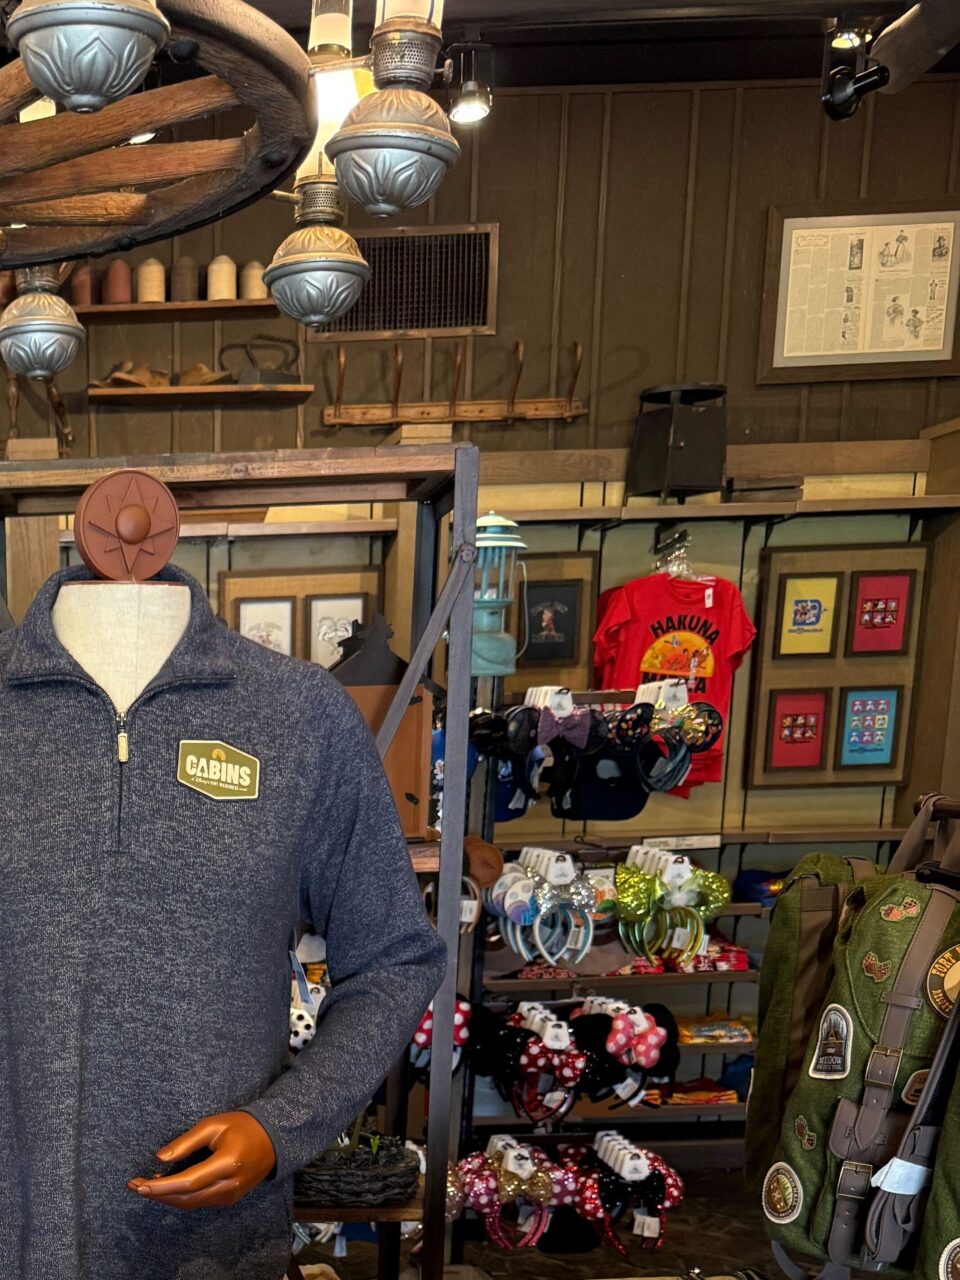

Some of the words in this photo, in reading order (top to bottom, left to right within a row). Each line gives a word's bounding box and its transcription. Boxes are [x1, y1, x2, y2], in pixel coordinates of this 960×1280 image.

[649, 615, 721, 647] HAKUNA
[185, 754, 251, 786] CABINS
[931, 952, 956, 978] FORT
